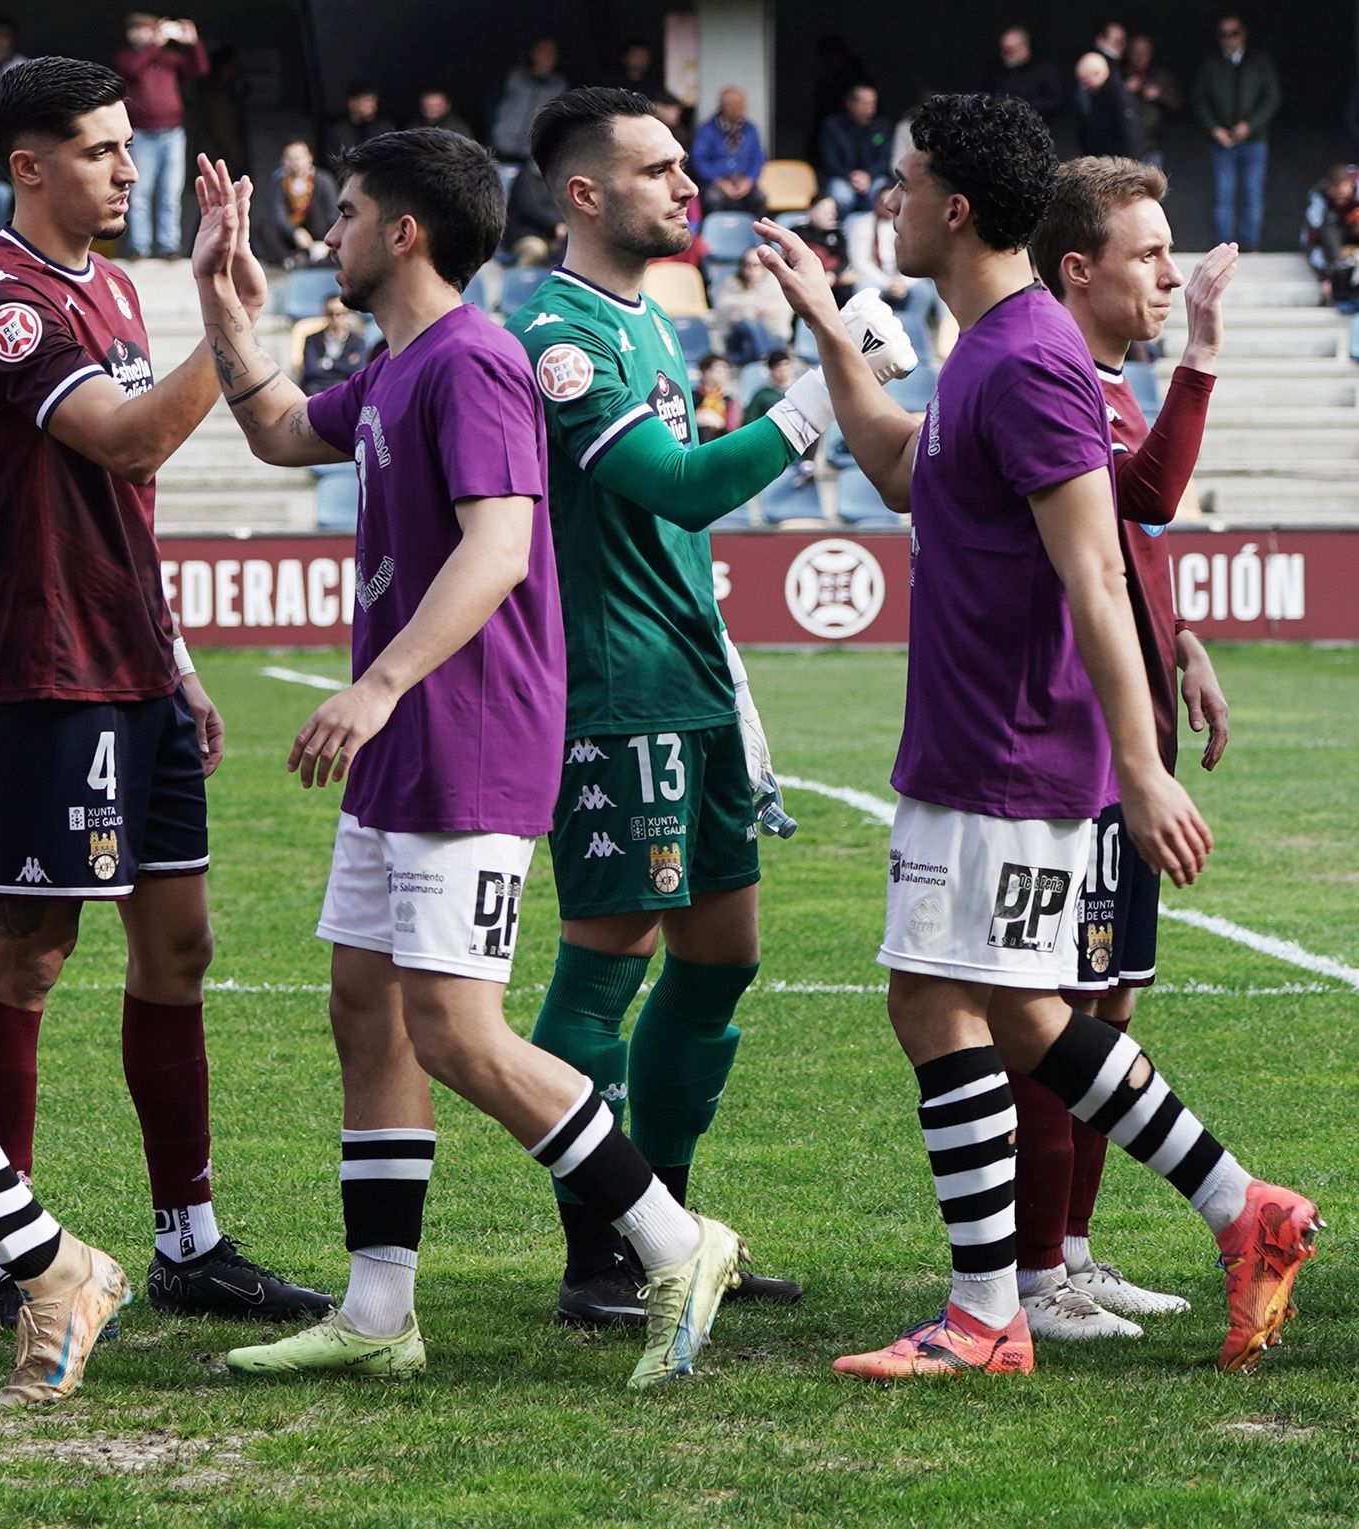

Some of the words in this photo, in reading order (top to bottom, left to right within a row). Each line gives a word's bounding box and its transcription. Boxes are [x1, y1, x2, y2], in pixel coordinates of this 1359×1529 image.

[1169, 543, 1305, 621] CIÓN
[161, 557, 355, 627] EDERACI
[86, 731, 117, 800] 4
[627, 732, 686, 803] 13
[87, 806, 117, 817] XUNTA
[87, 818, 100, 828] DE
[648, 816, 679, 827] XUNTA
[648, 827, 661, 837] DE
[1086, 822, 1121, 893] 10
[400, 882, 444, 895] Salamanca
[1087, 899, 1115, 911] XUNTA
[1086, 911, 1099, 921] DE
[344, 1346, 392, 1366] ULTRA
